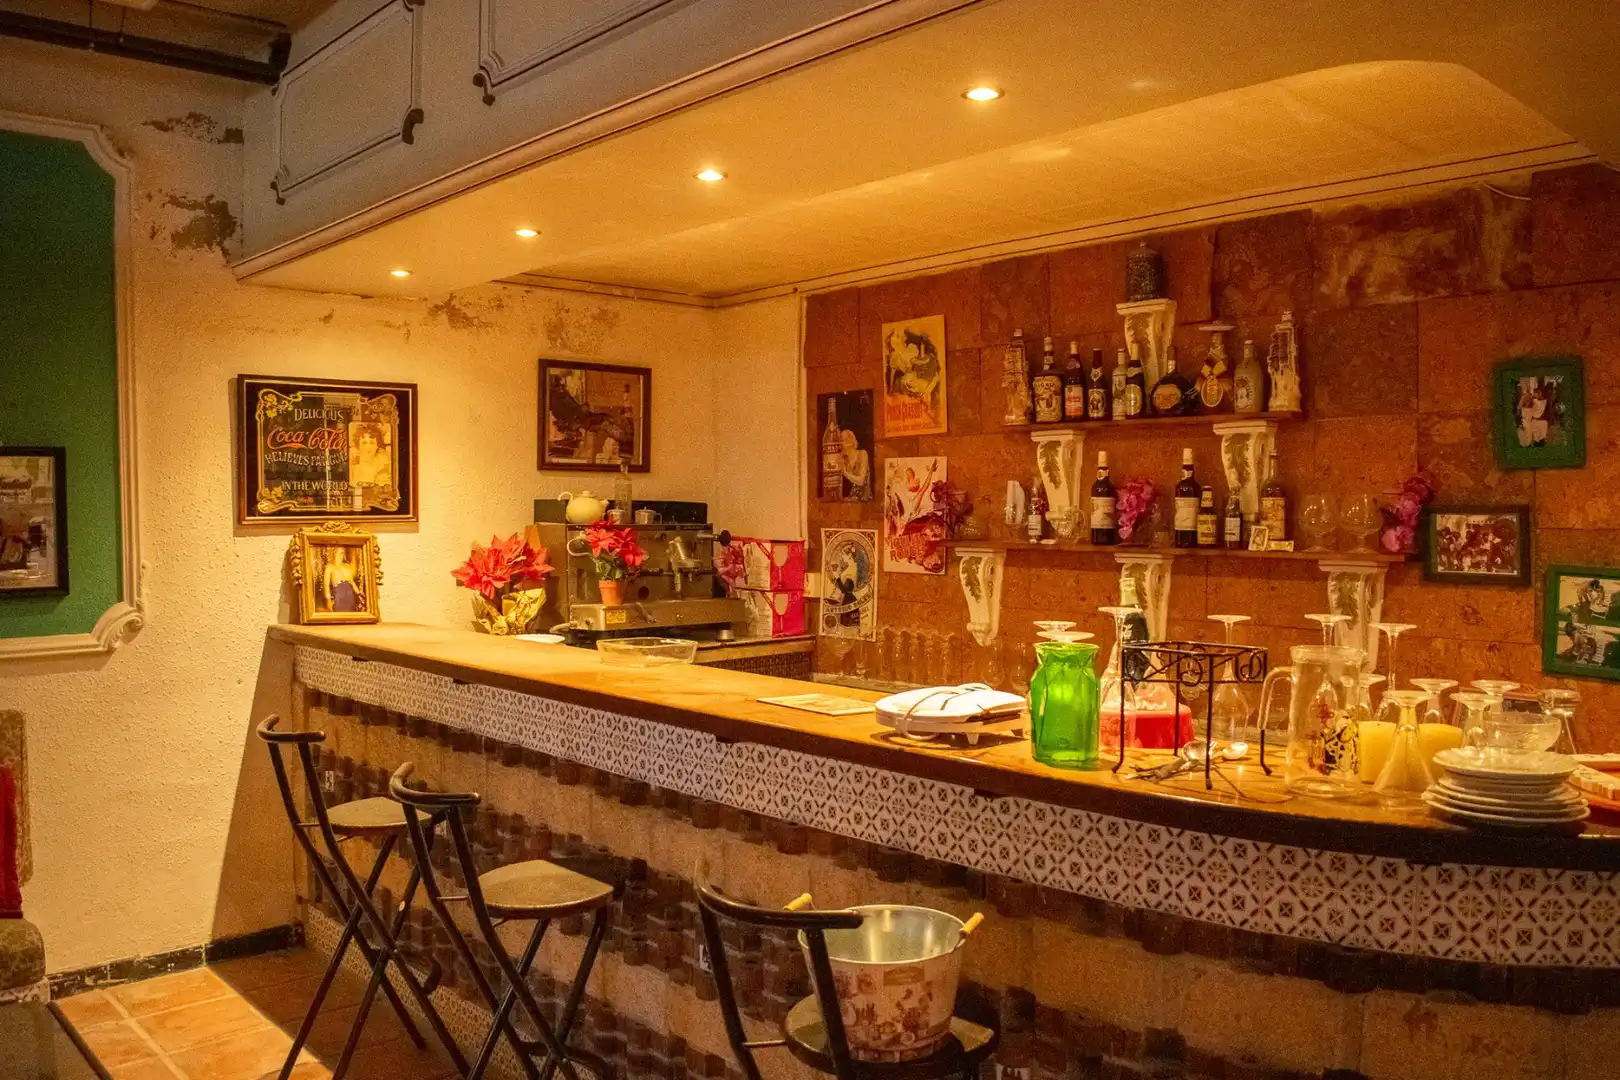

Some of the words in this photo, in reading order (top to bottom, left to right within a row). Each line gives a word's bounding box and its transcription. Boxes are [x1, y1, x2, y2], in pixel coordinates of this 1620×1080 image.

[294, 408, 345, 422] DELICIOUS
[264, 451, 310, 466] RELIEVES
[281, 480, 291, 490] IN
[292, 480, 310, 491] THE
[311, 480, 349, 491] WORLD
